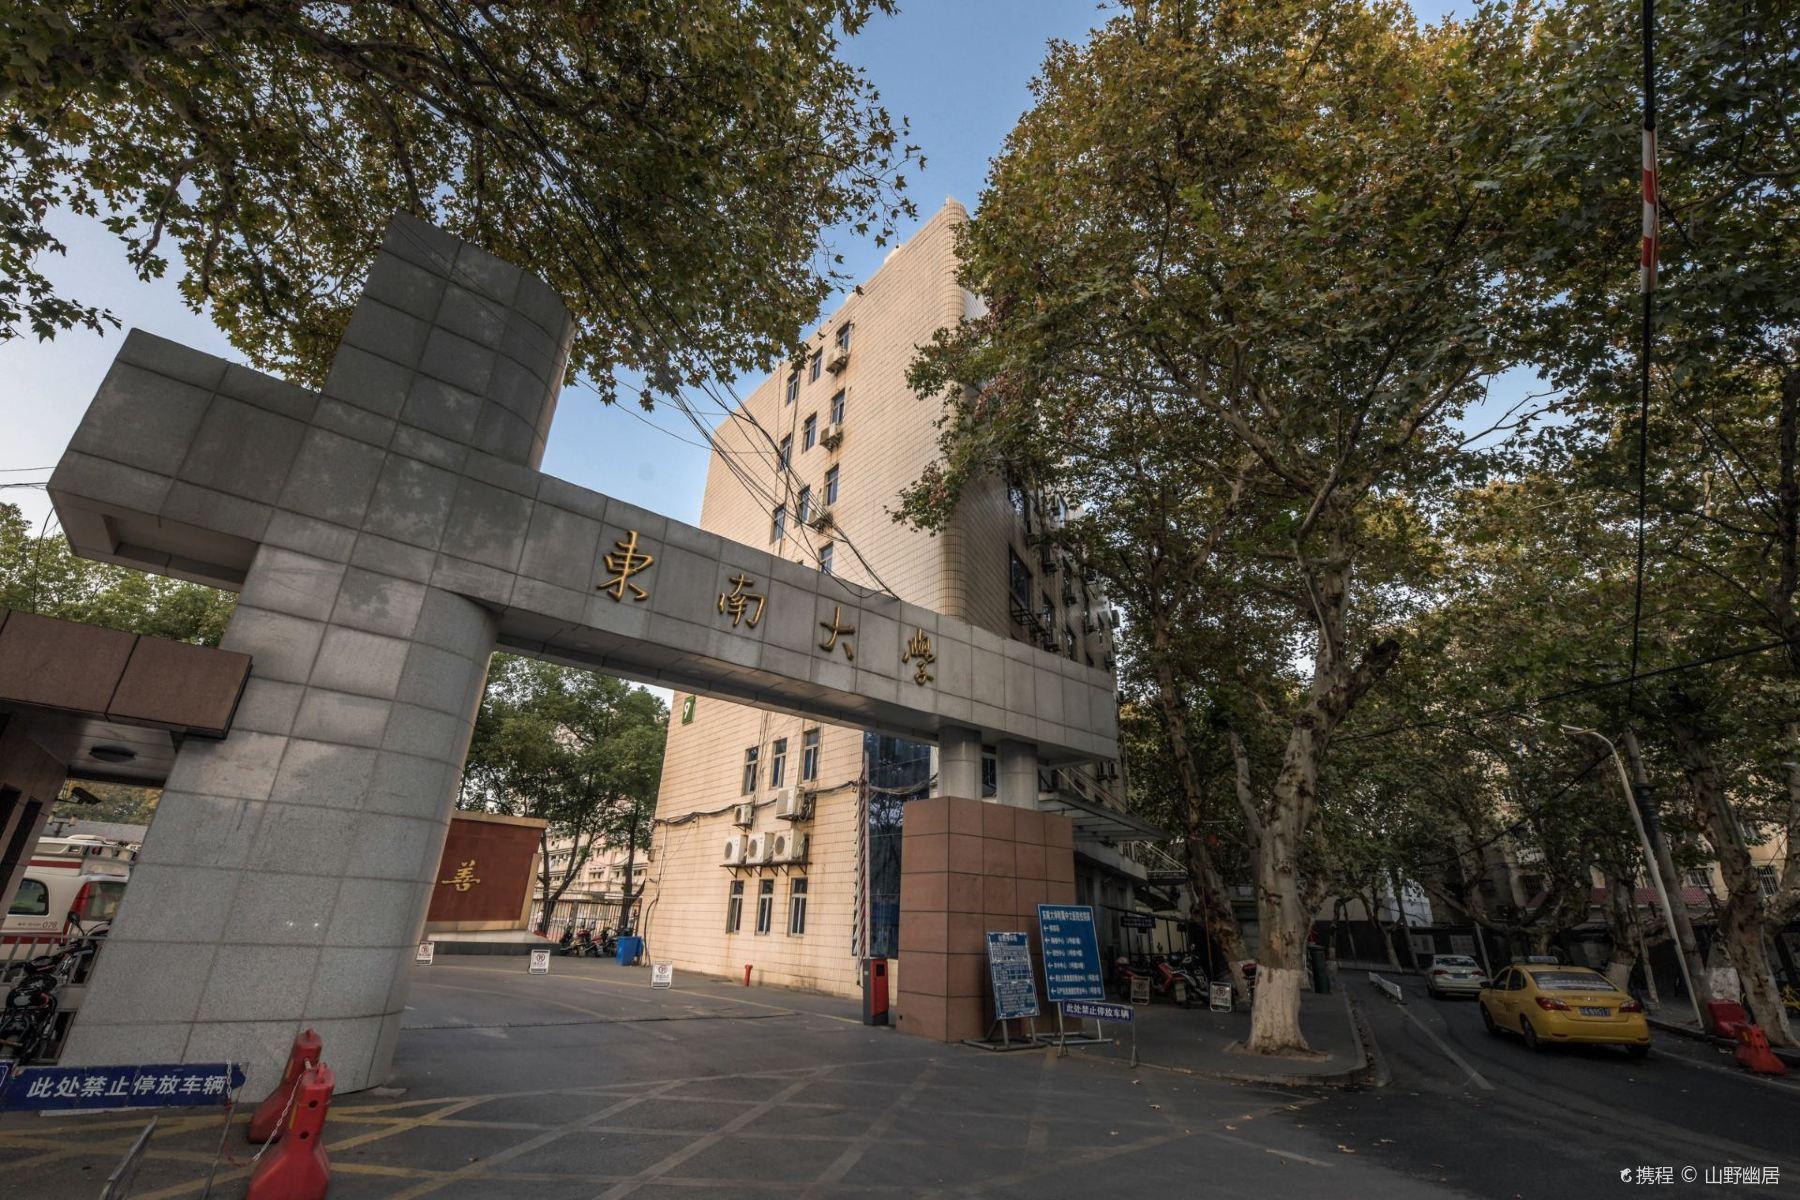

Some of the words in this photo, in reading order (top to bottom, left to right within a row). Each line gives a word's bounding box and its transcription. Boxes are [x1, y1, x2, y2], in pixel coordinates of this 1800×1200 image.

[597, 530, 936, 686] 東南大學
[684, 702, 691, 719] 9
[441, 860, 480, 891] 善
[1066, 1003, 1129, 1019] 此处禁止停放车辆
[26, 1074, 228, 1098] 此处禁止停放车辆
